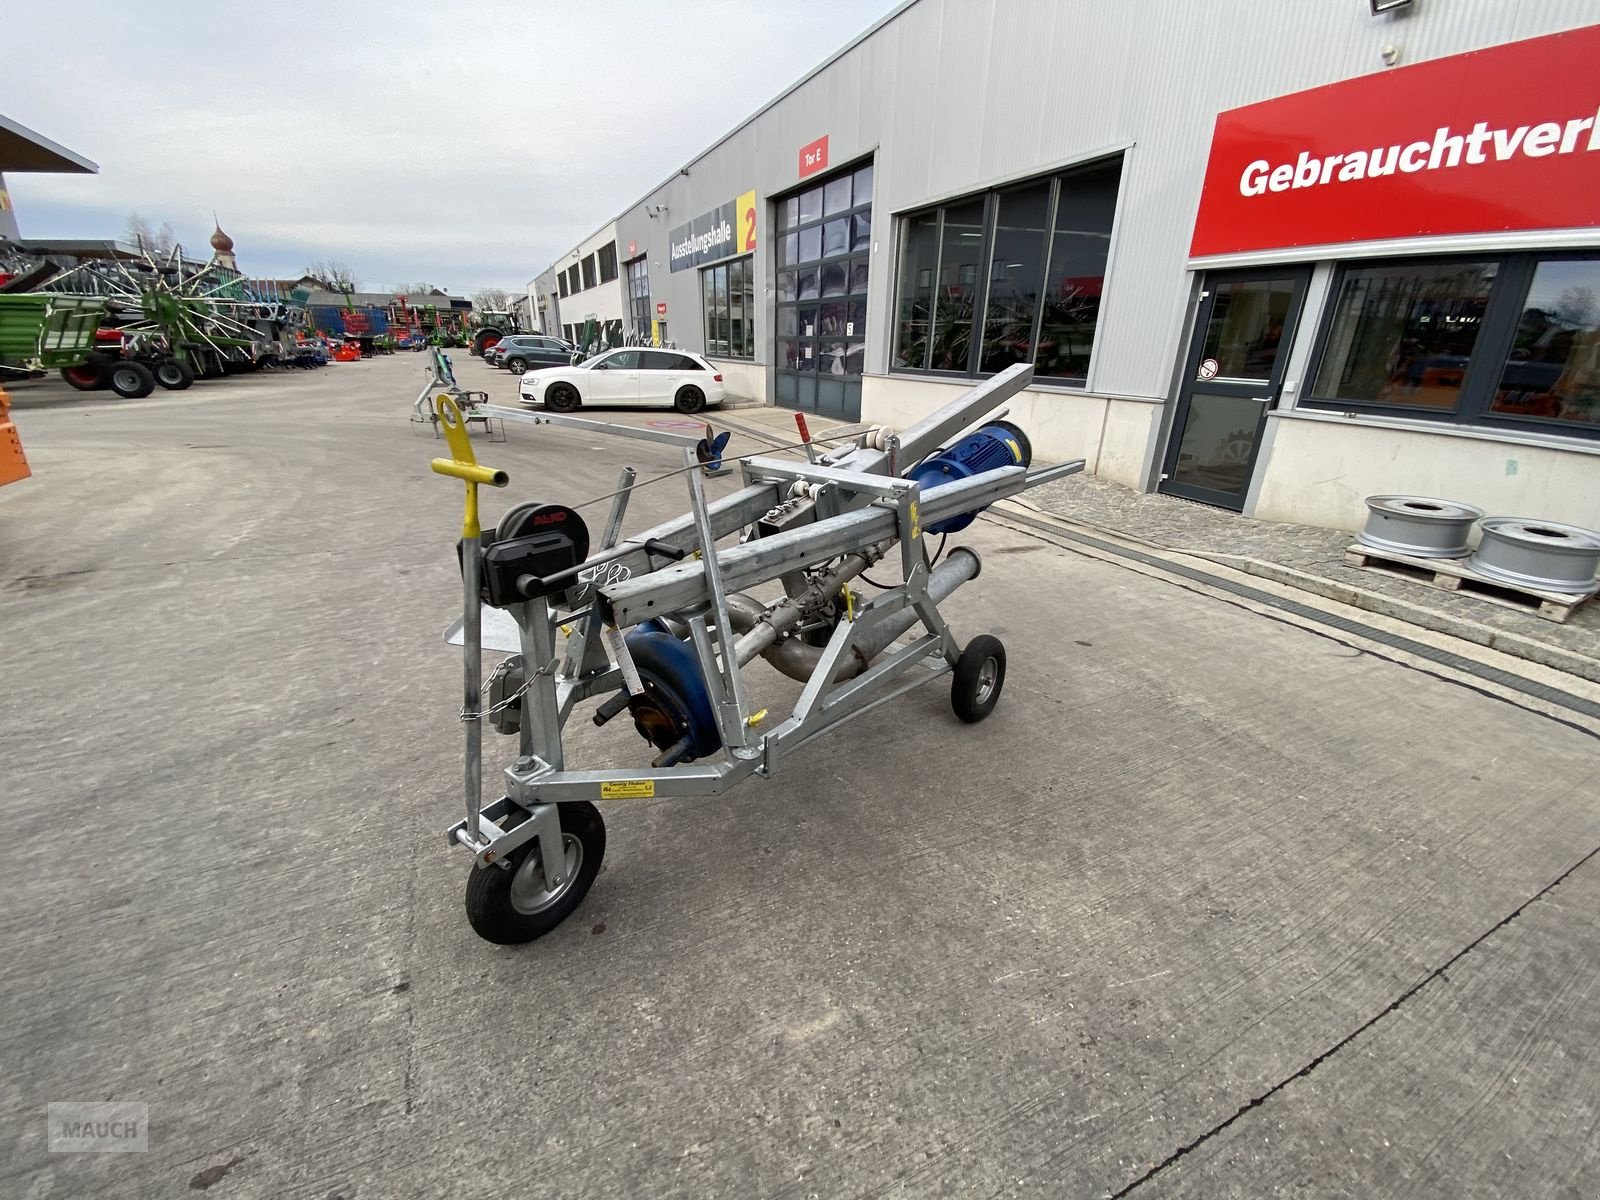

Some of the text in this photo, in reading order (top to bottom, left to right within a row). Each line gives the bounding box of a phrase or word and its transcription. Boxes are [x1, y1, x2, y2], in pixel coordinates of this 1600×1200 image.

[805, 148, 821, 167] Tor E
[671, 207, 757, 261] Ausstellungshalle 2
